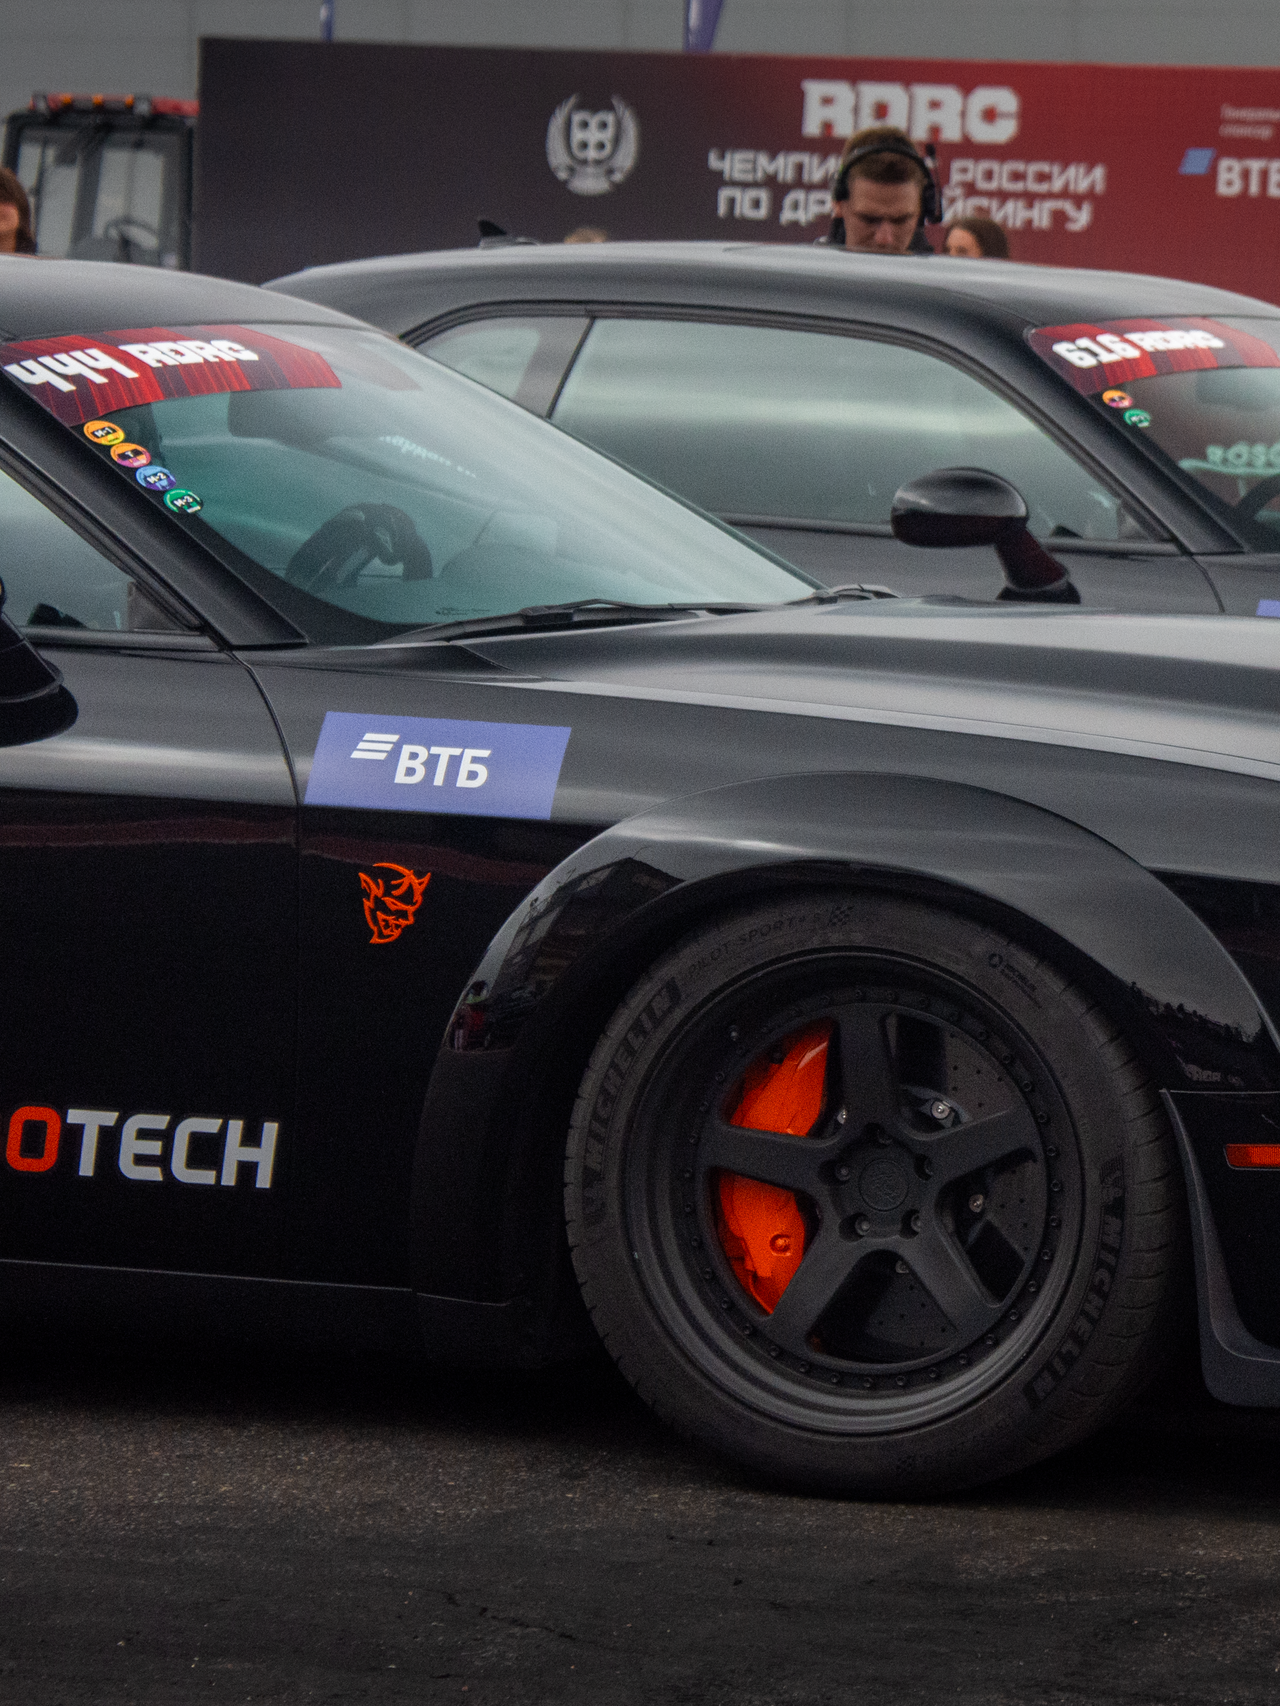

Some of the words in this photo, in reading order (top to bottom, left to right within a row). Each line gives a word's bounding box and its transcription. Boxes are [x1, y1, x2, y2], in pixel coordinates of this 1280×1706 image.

[801, 79, 1021, 144] RDRC
[707, 147, 845, 185] ЧЕМПИ
[949, 157, 1106, 195] РОССИИ
[717, 186, 770, 220] ПО
[3, 347, 139, 393] 444
[119, 339, 259, 368] RDRC
[1052, 333, 1141, 369] 616
[393, 744, 492, 789] ВТБ
[584, 983, 672, 1174] MICHELIN
[6, 1105, 279, 1189] OTECH
[1030, 1211, 1123, 1403] MICHELIN
